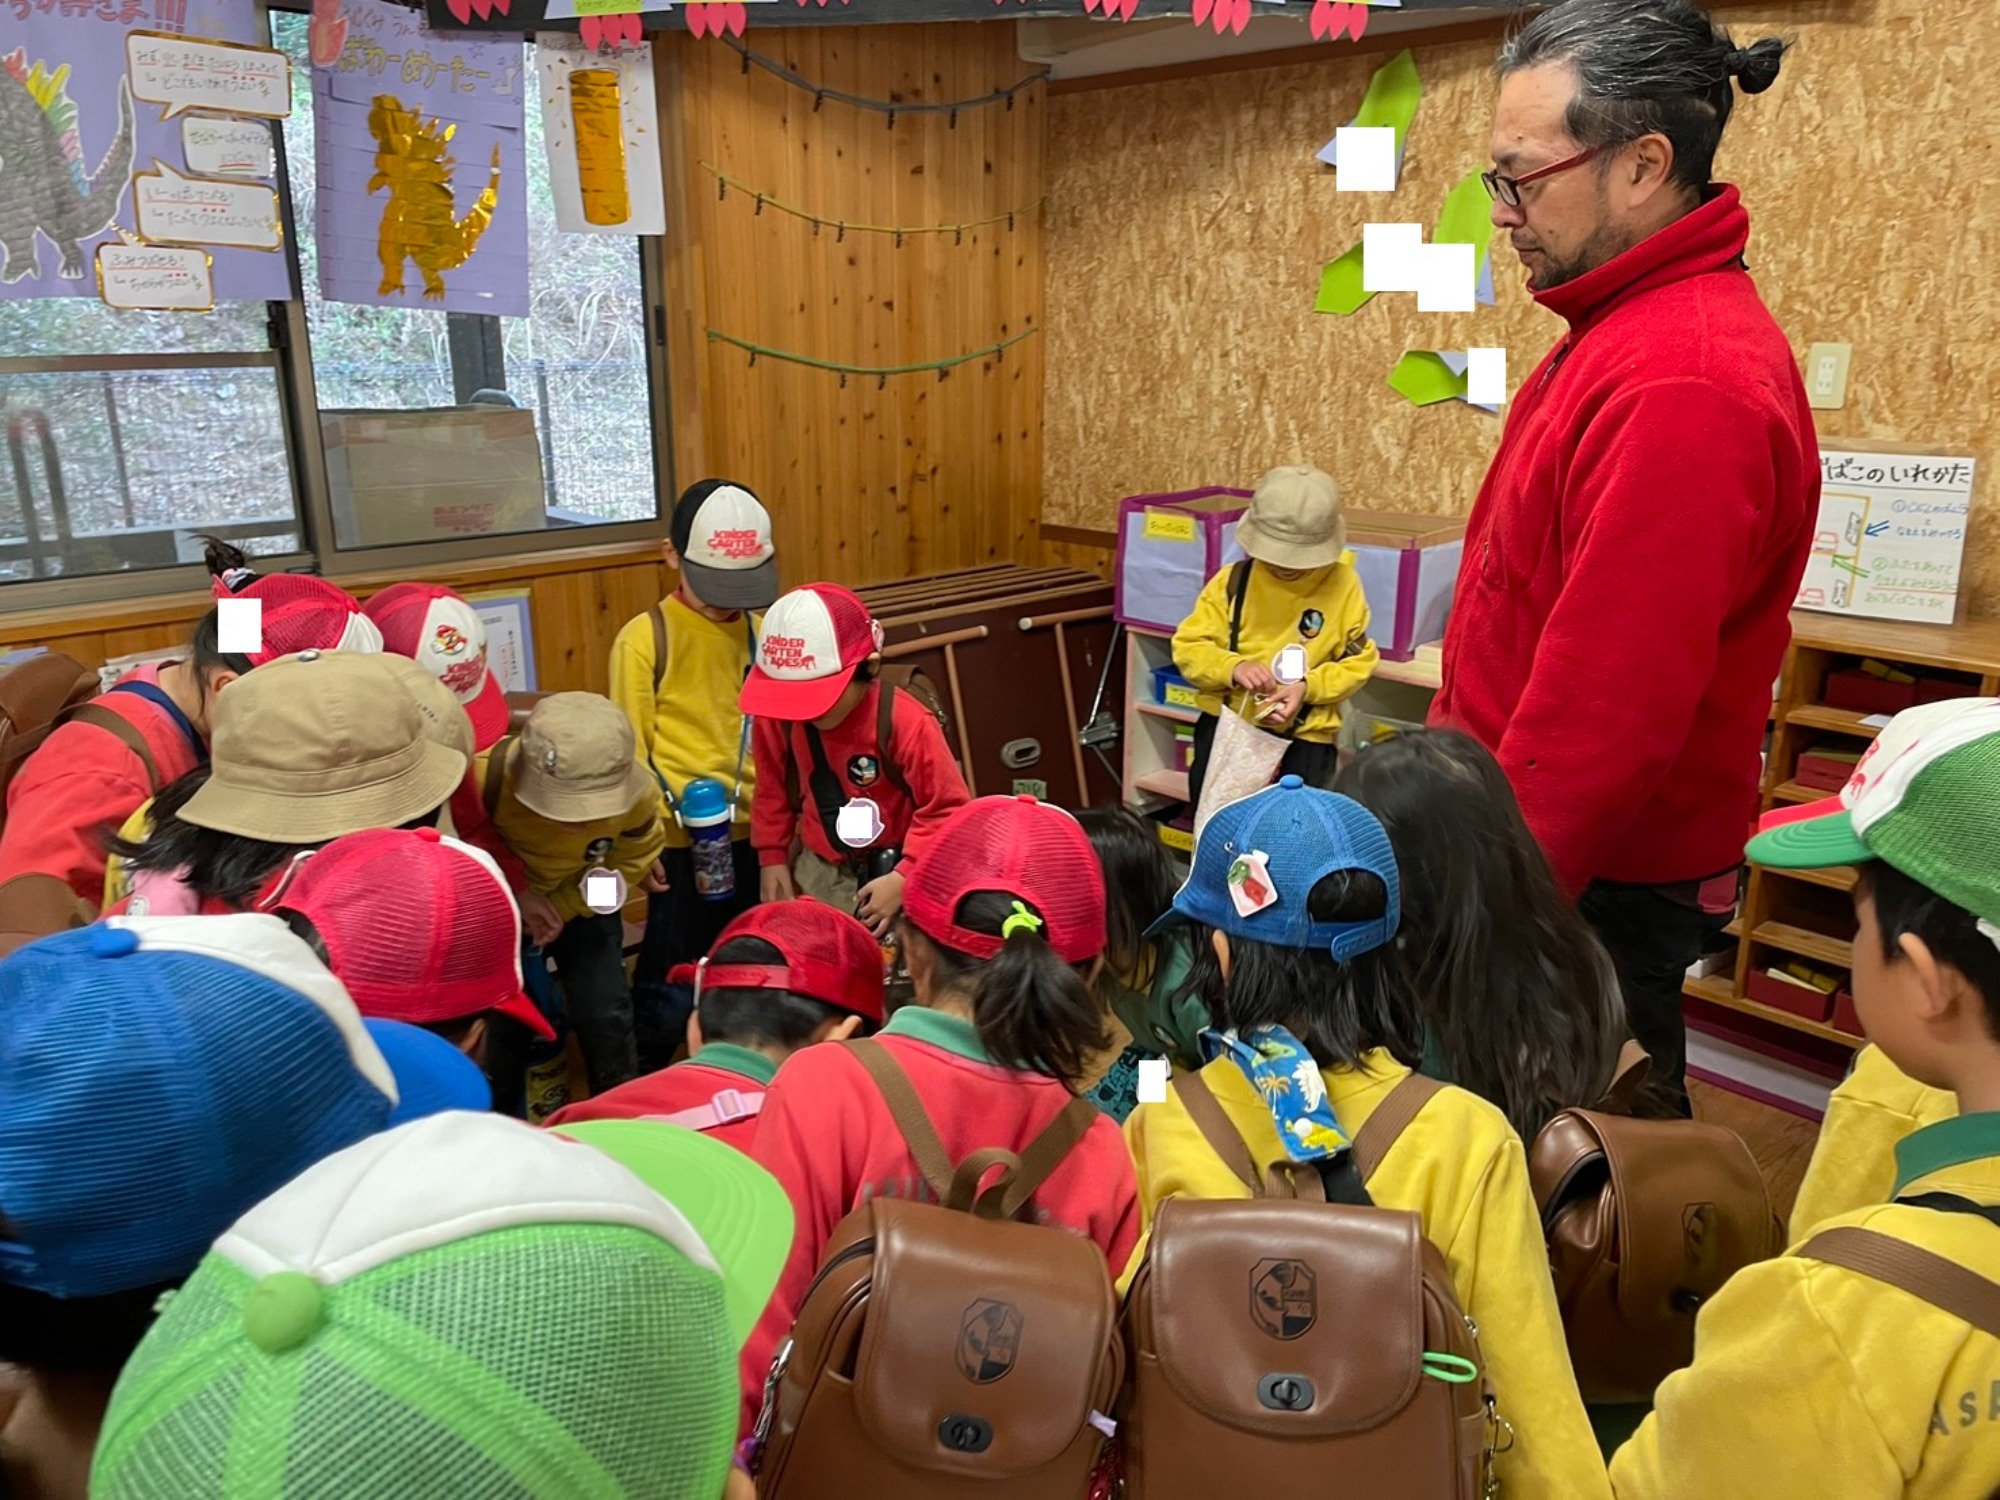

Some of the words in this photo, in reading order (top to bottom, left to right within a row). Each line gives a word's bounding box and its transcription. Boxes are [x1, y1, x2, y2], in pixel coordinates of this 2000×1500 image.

[1820, 456, 1970, 485] ばこのいれかた
[766, 634, 806, 648] KINDER
